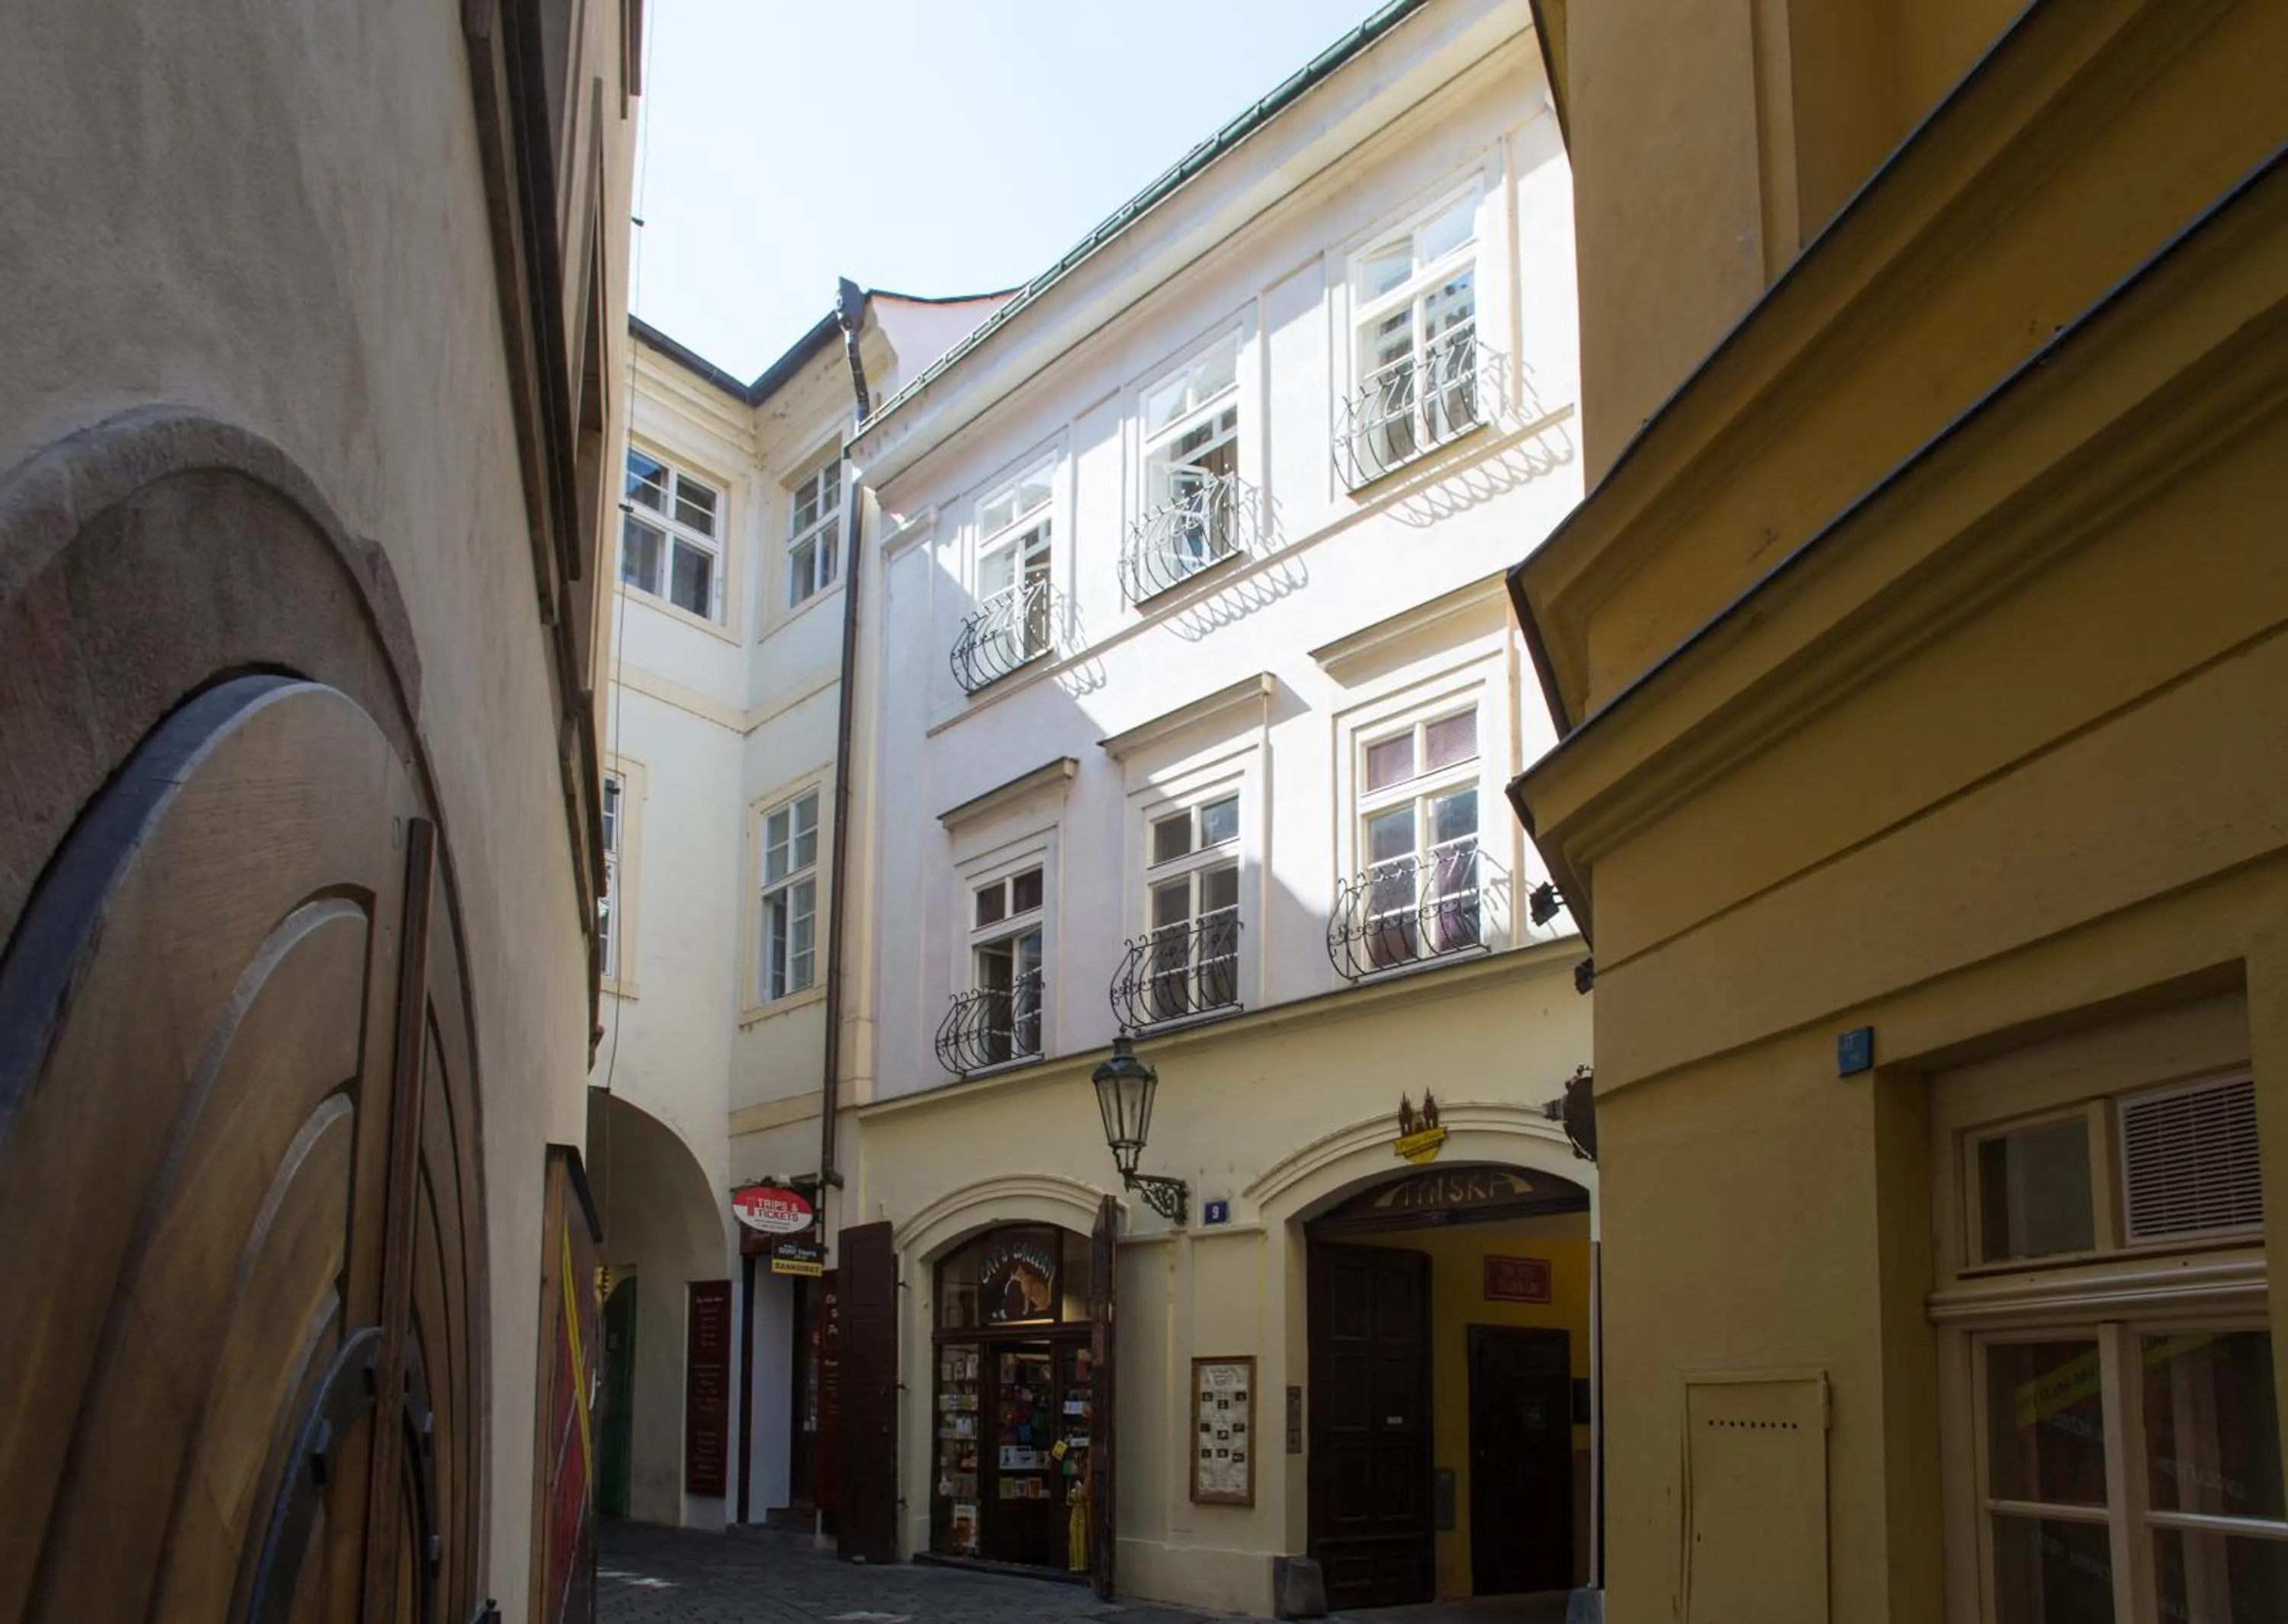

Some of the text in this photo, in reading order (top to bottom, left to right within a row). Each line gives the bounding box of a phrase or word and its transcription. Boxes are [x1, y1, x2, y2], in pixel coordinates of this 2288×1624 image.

[757, 1197, 799, 1212] TRIPS &
[757, 1208, 799, 1222] TICKETS
[1212, 1205, 1220, 1219] 9
